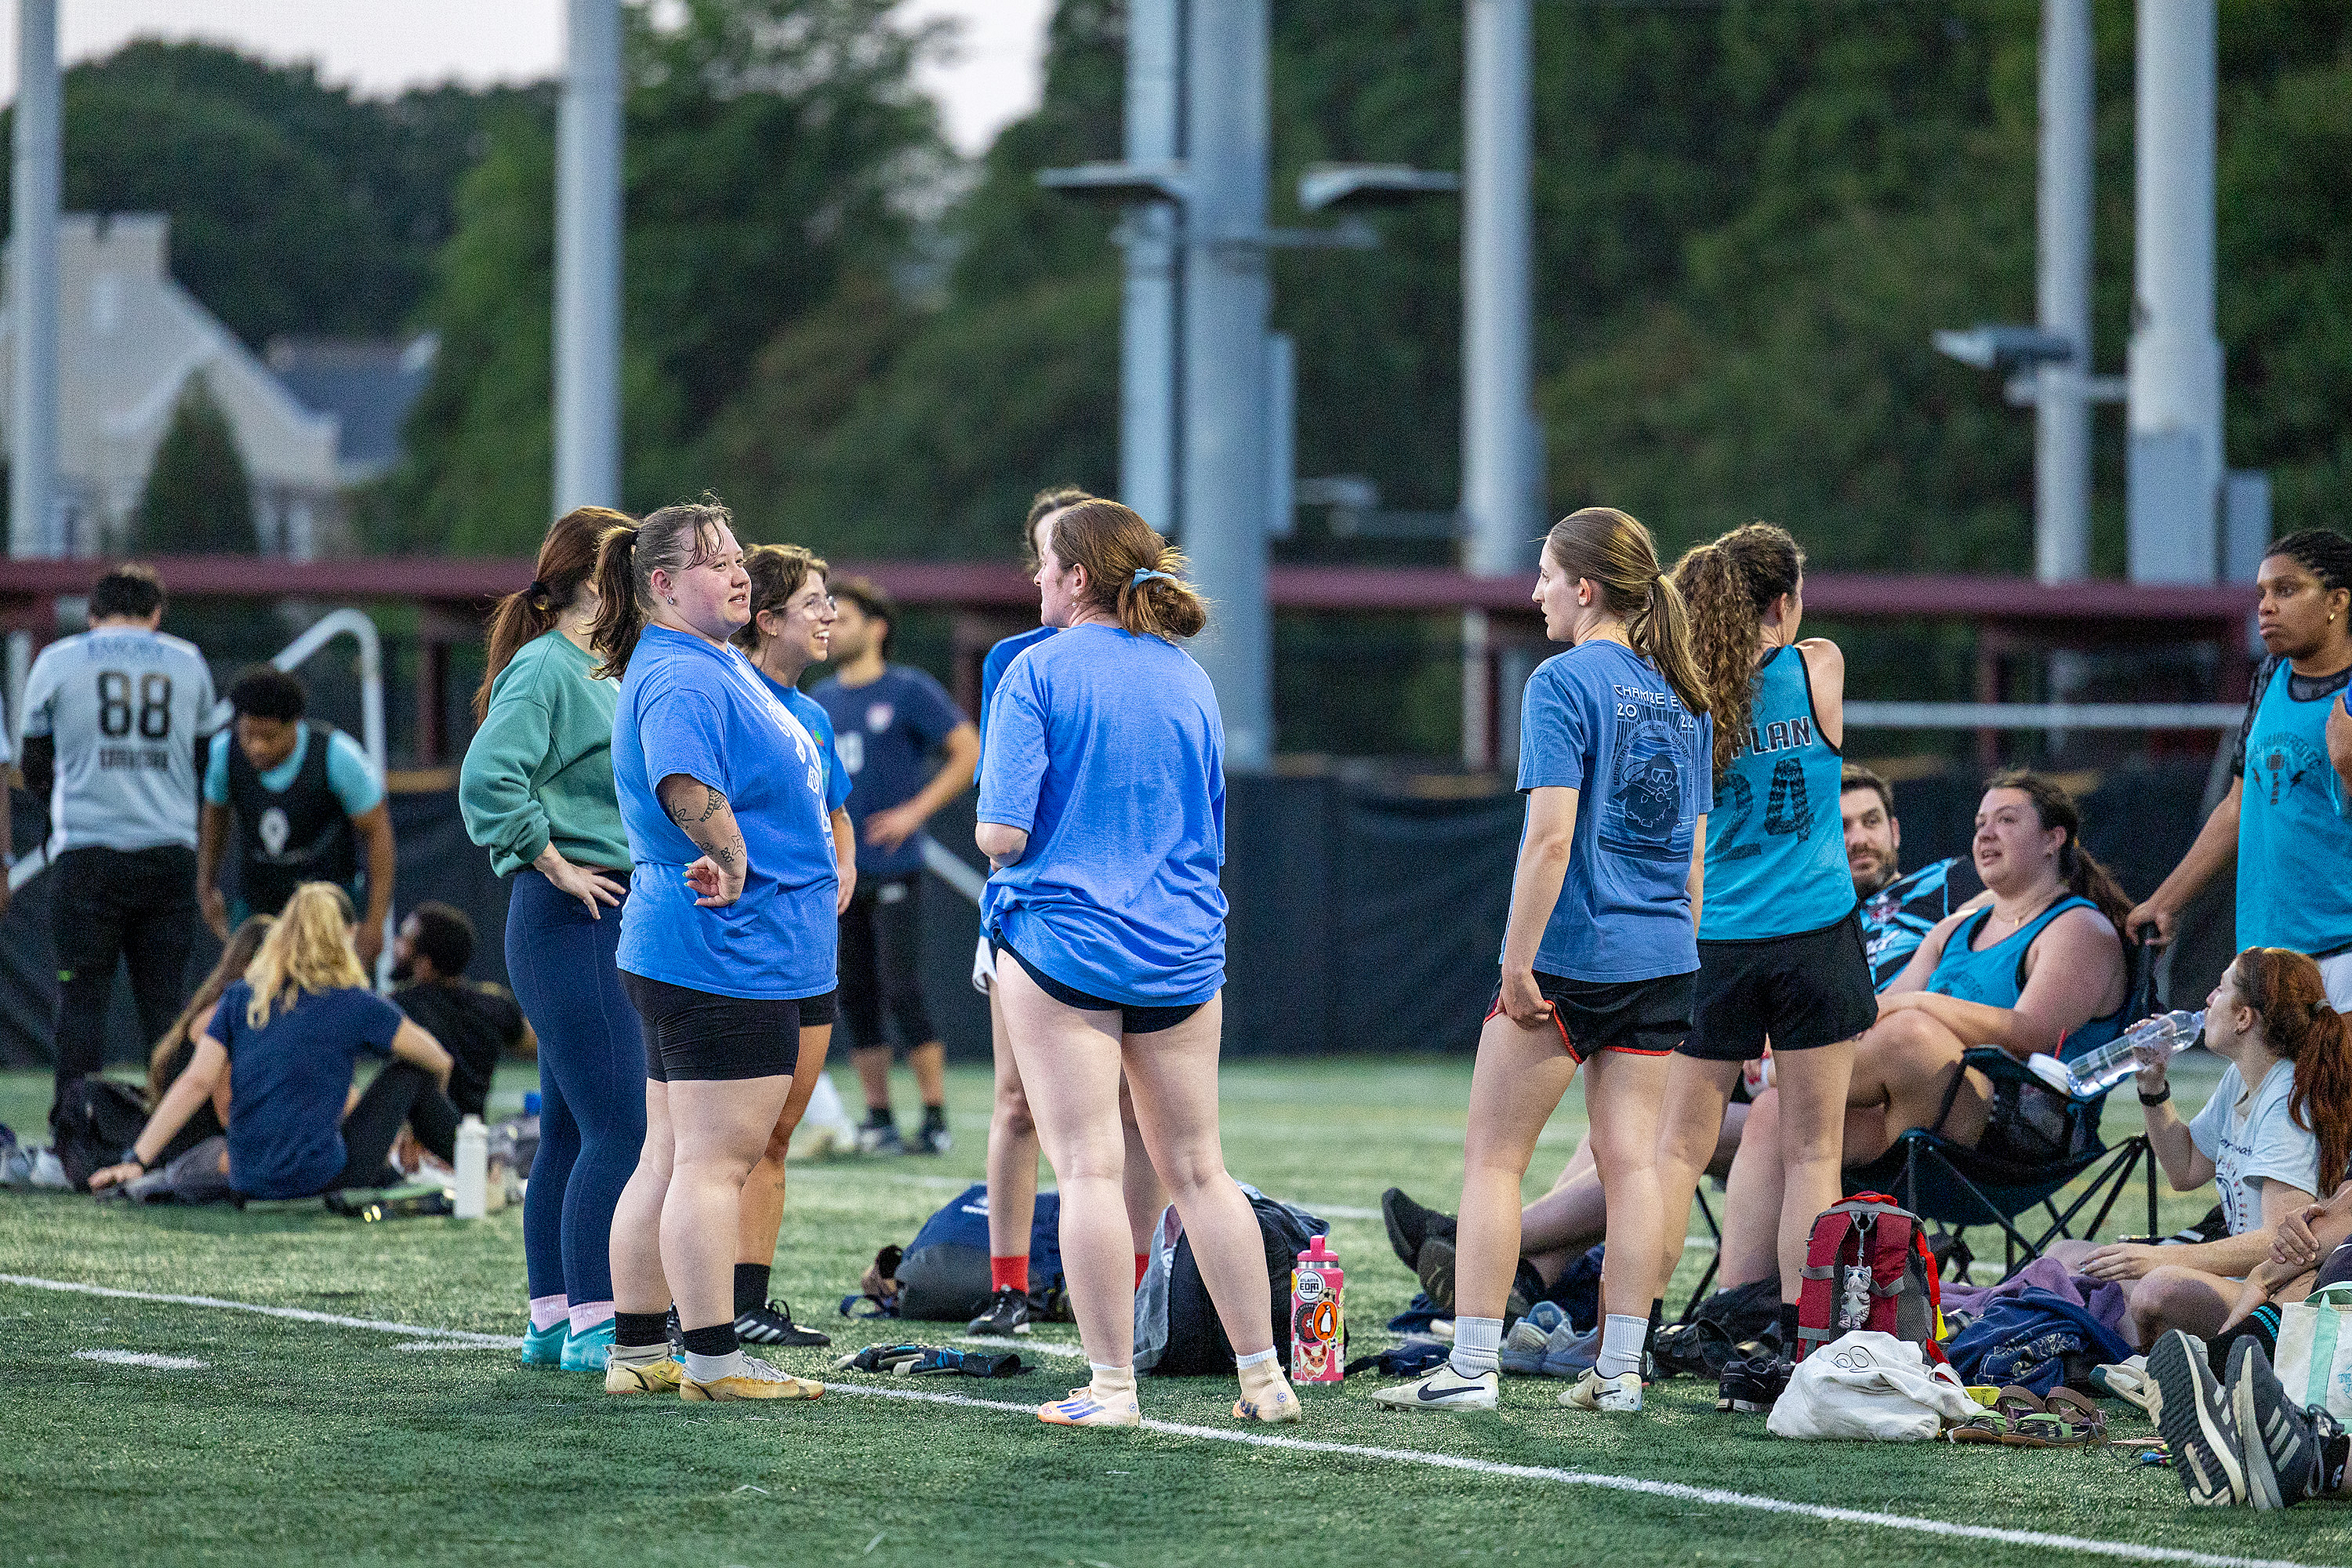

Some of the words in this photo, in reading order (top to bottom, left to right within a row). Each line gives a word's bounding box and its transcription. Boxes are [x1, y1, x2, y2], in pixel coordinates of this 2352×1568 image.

[97, 670, 173, 742] 88
[1617, 702, 1638, 718] 20
[1680, 713, 1694, 728] 22
[1628, 732, 1641, 745] THE
[1713, 757, 1816, 862] 24
